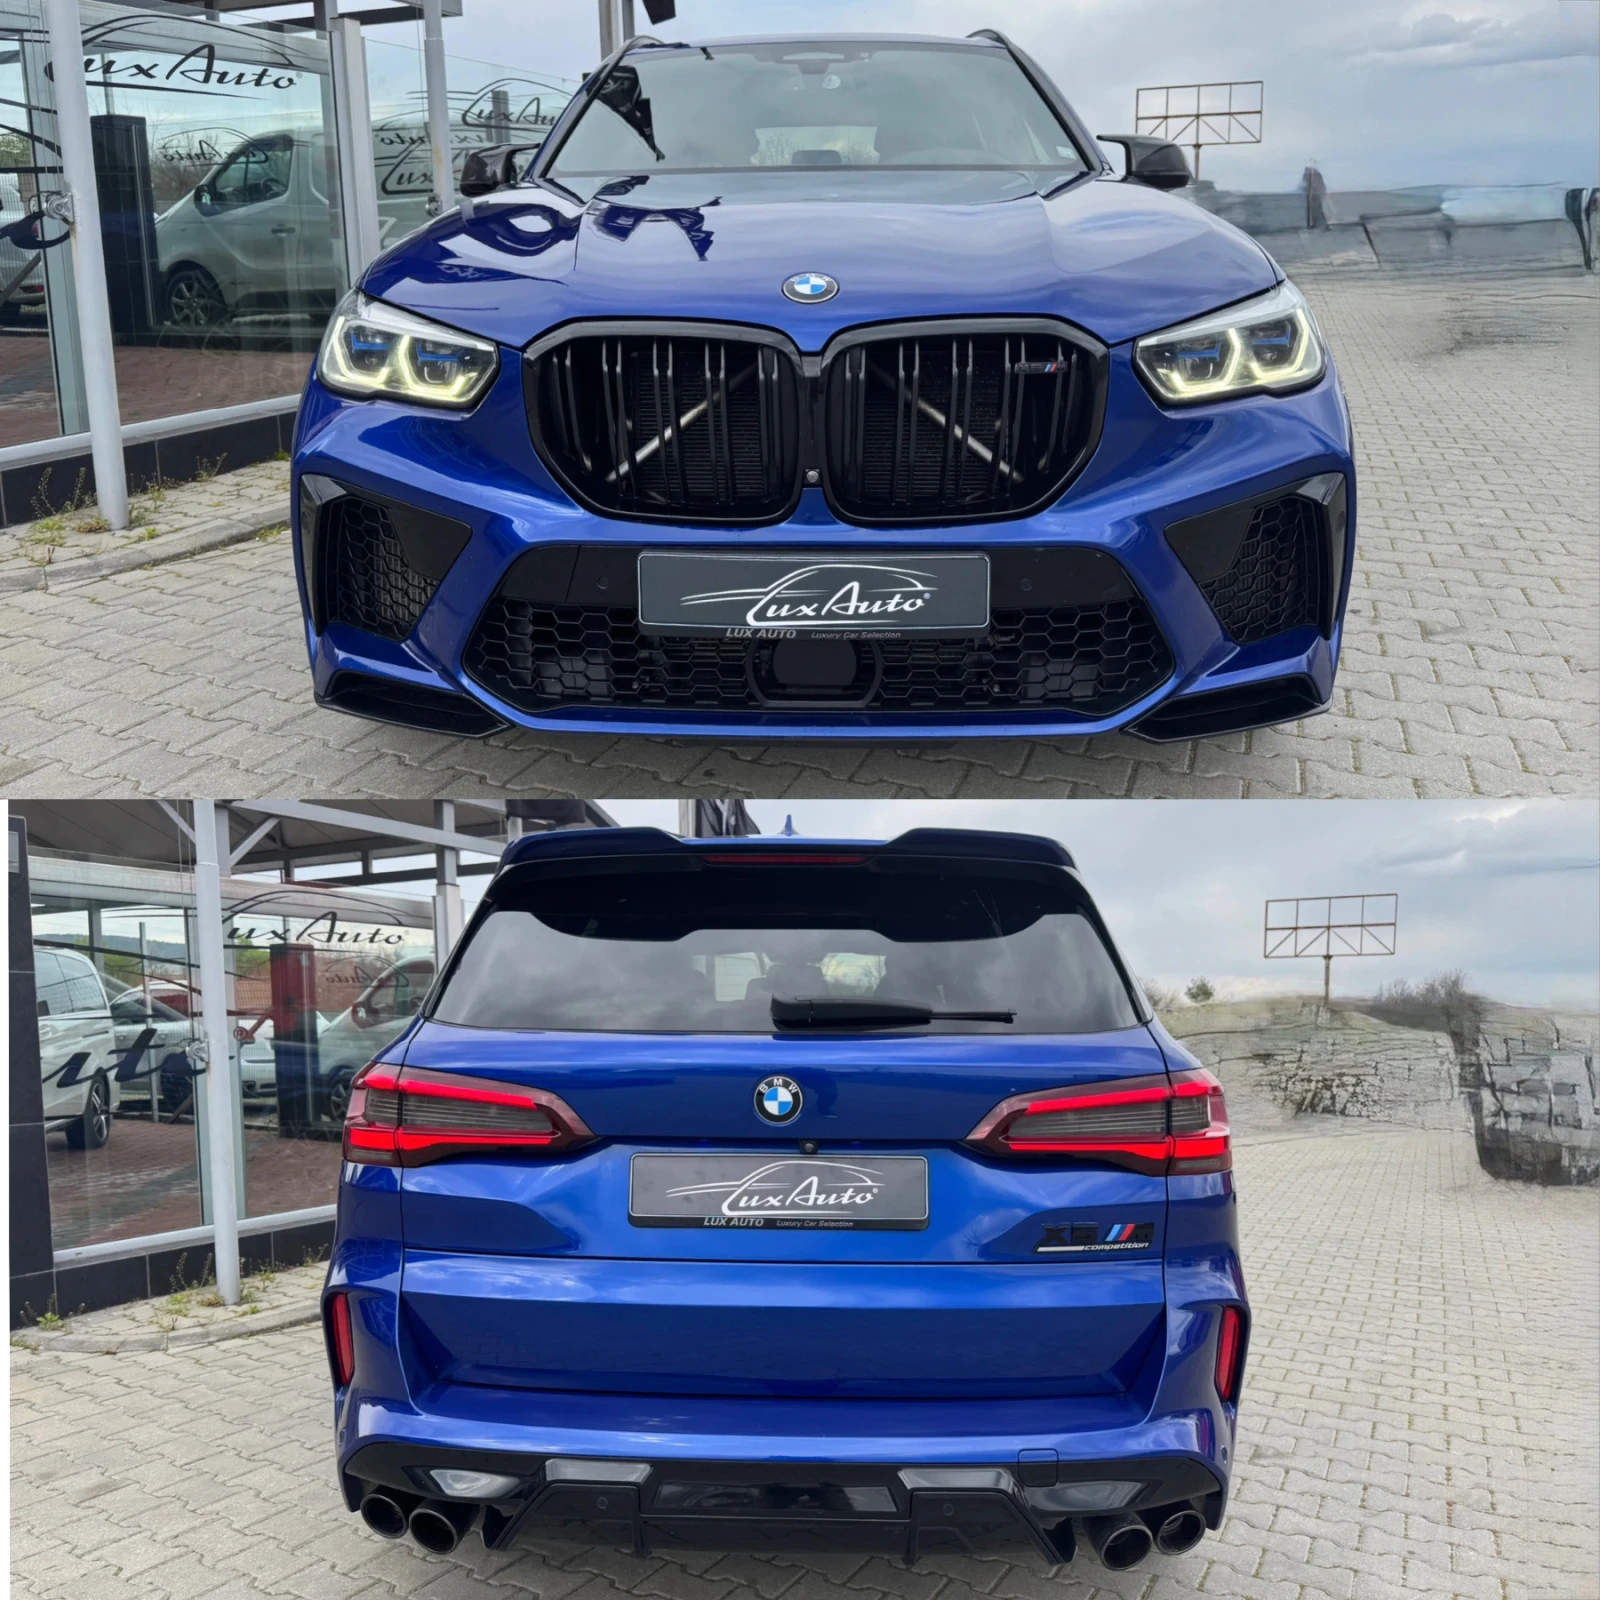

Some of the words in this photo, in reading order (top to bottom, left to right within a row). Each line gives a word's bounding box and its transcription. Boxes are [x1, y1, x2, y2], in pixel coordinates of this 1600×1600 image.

[165, 44, 297, 89] Auto
[746, 583, 819, 626] Lux
[725, 628, 752, 639] LUX
[756, 629, 797, 639] AUTO
[811, 631, 842, 640] Luxury
[843, 631, 859, 640] Car
[861, 630, 902, 639] Selection
[296, 911, 403, 945] Auto
[759, 1078, 799, 1094] BMW
[721, 1176, 784, 1216] Lux
[703, 1217, 728, 1227] LUX
[730, 1217, 765, 1227] AUTO
[776, 1219, 802, 1228] Luxury
[803, 1219, 818, 1228] Car
[818, 1220, 854, 1228] Selection
[1084, 1242, 1150, 1252] competition
